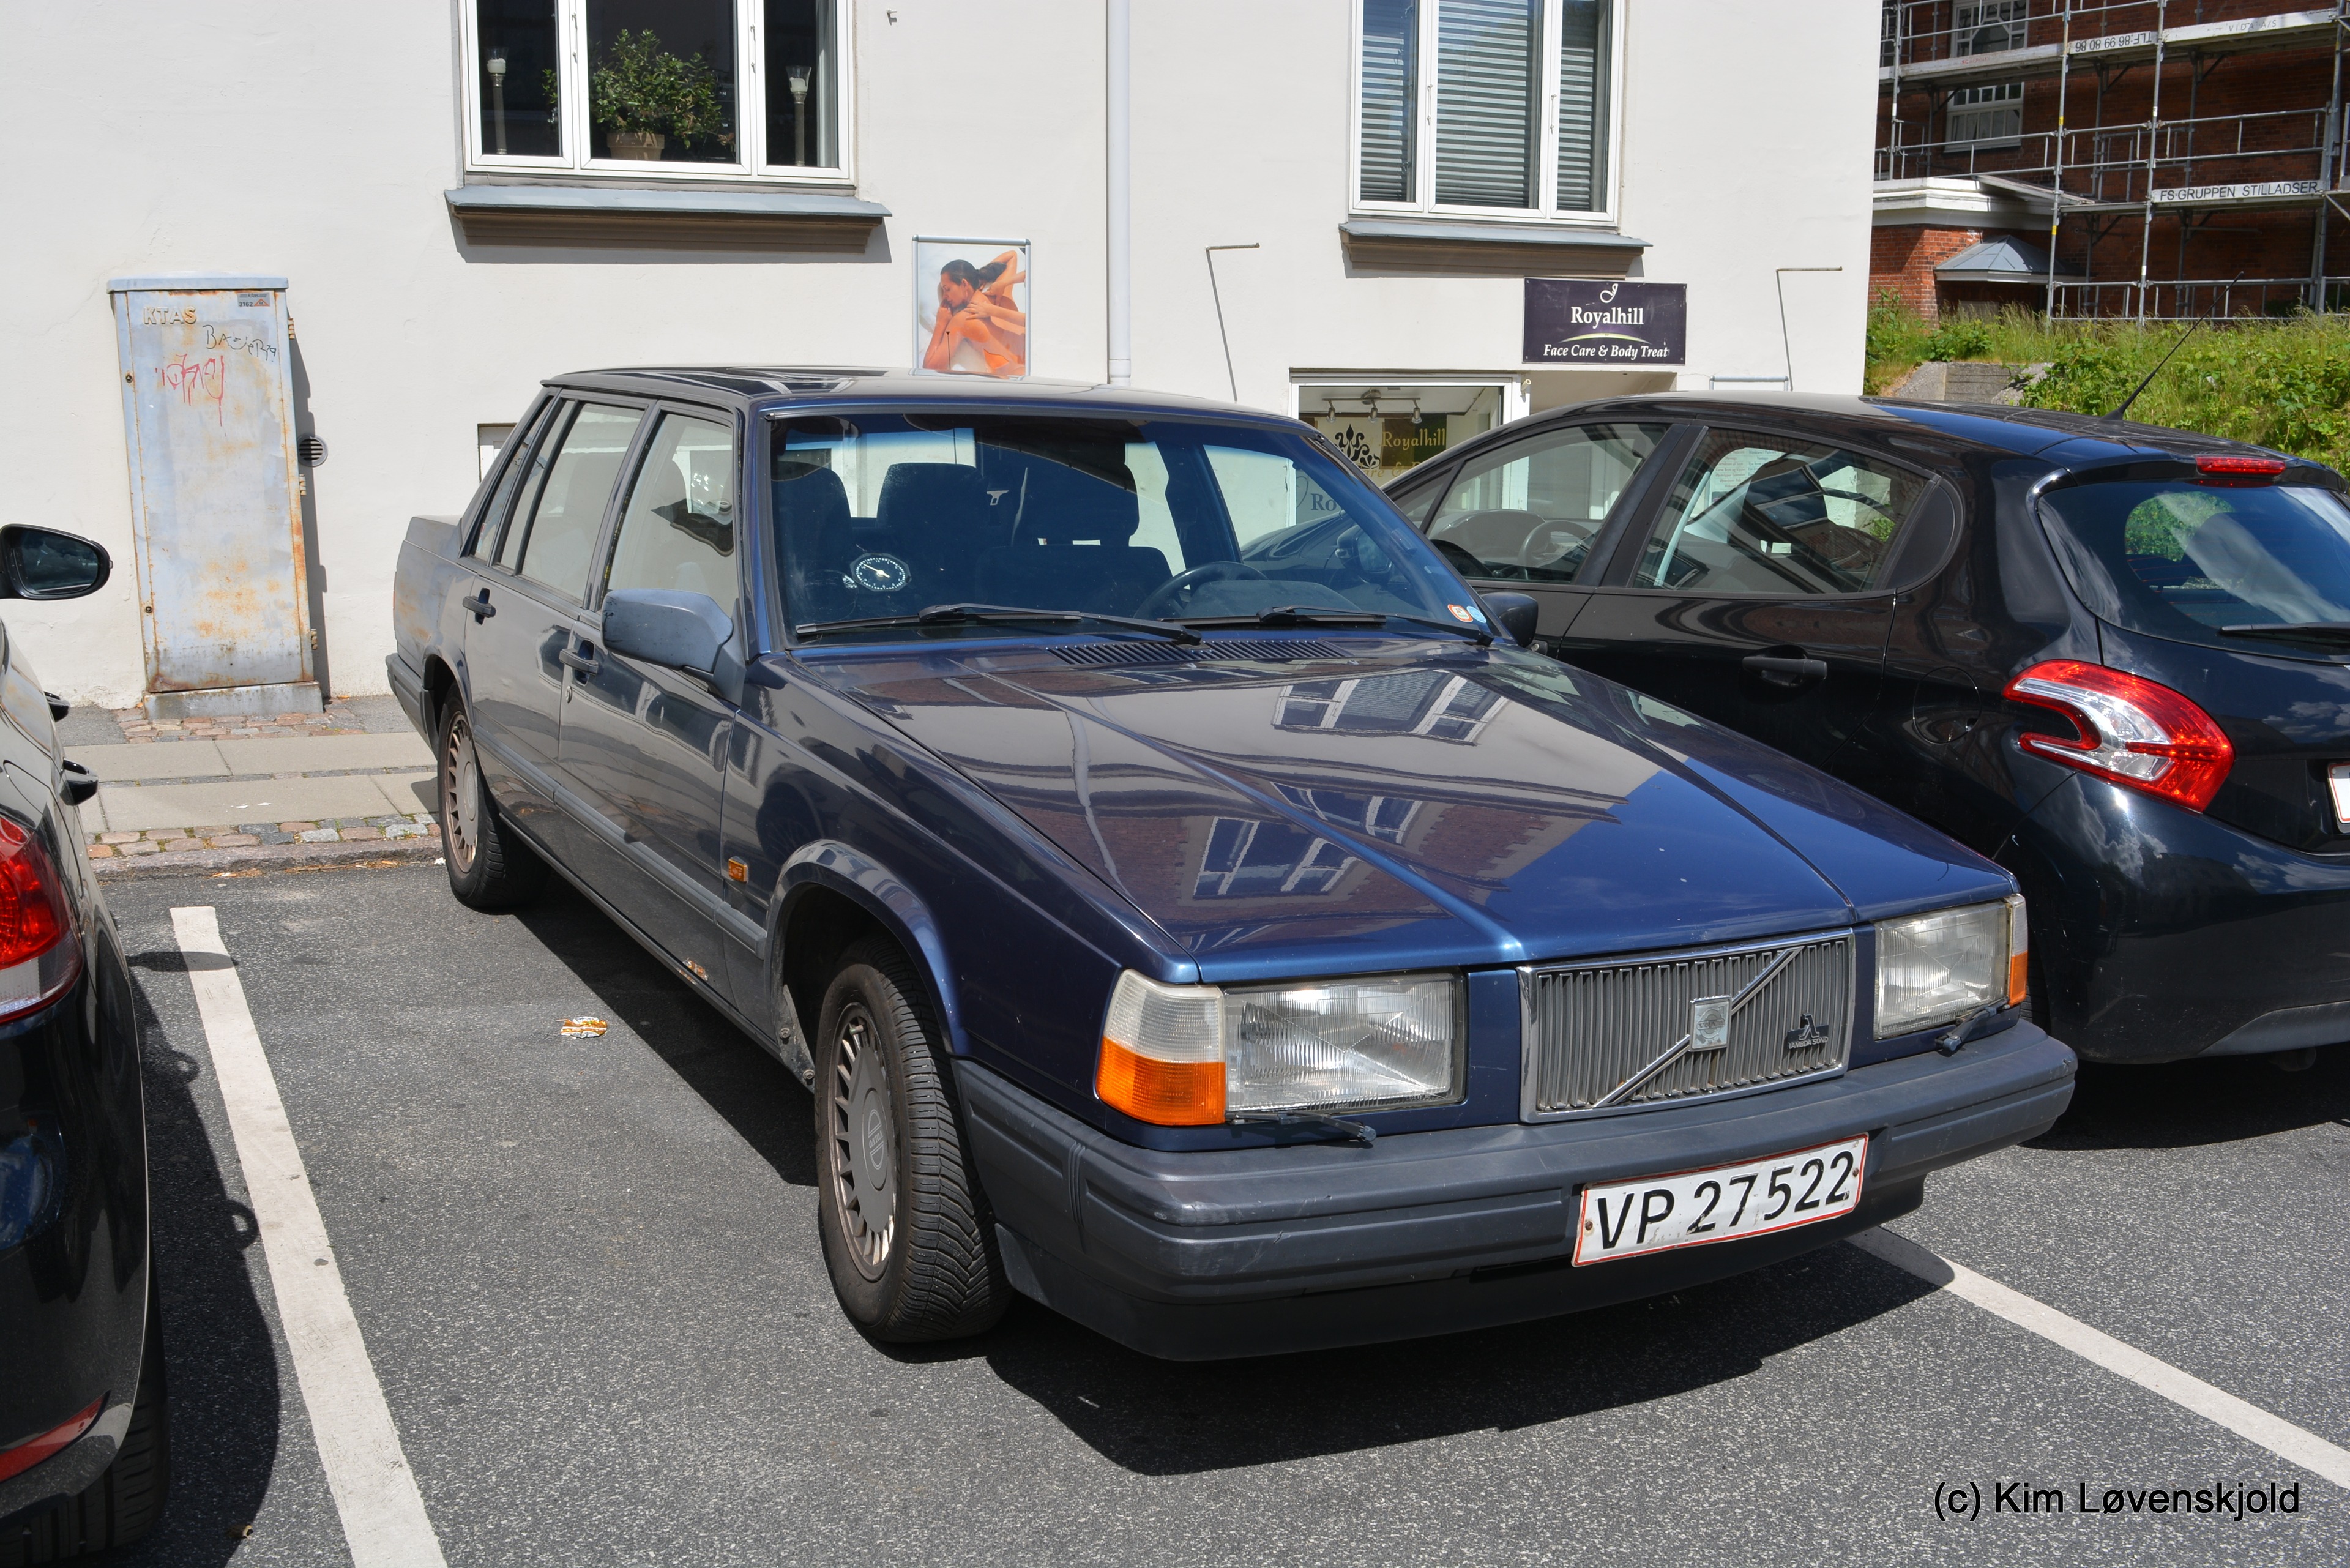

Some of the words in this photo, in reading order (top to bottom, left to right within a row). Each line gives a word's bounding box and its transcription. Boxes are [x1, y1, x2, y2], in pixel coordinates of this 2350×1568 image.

[2242, 182, 2318, 196] STILLADSER
[143, 307, 197, 324] KTAS
[1571, 307, 1644, 329] Royalhill
[1543, 344, 1569, 357] Face
[1571, 345, 1595, 357] Care
[1598, 345, 1608, 356] &
[1611, 346, 1638, 360] Body
[1641, 346, 1668, 358] Treat
[1382, 428, 1446, 451] Royalhill
[1789, 1040, 1811, 1049] LAMBDA
[1813, 1036, 1829, 1045] SOND
[1597, 1188, 1676, 1250] VP
[1685, 1149, 1854, 1236] 27522
